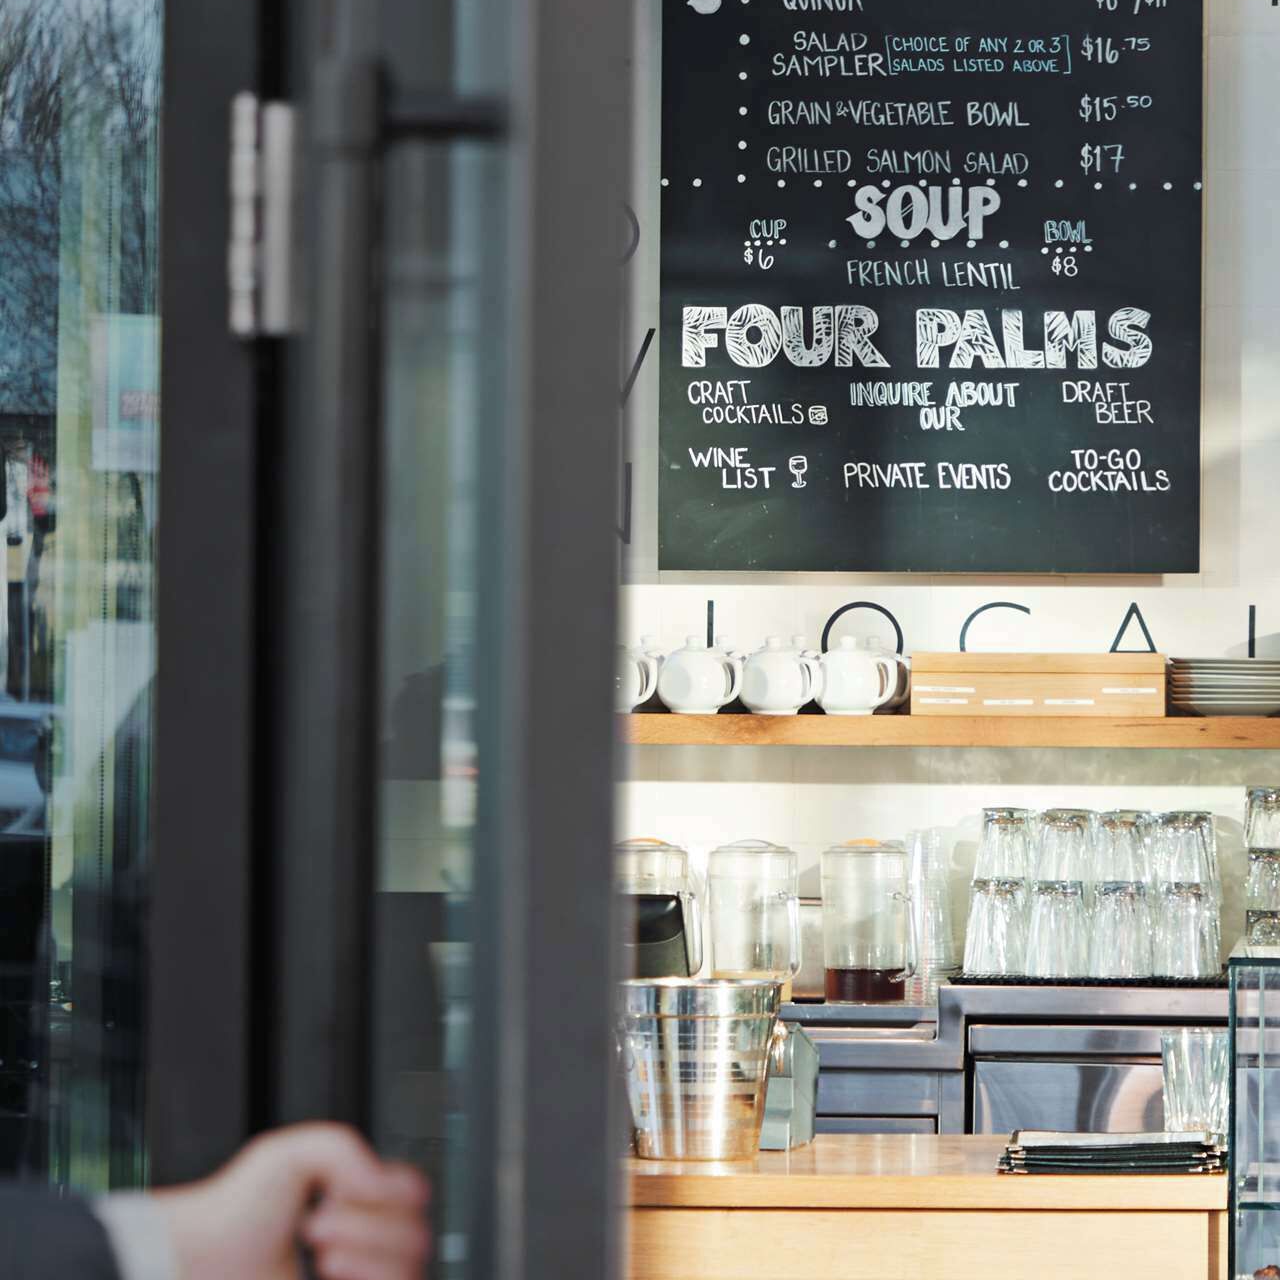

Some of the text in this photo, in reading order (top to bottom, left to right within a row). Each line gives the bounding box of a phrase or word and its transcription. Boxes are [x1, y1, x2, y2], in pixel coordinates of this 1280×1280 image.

[793, 31, 868, 51] SALAD
[892, 37, 949, 52] CHOICE
[955, 37, 971, 52] OF
[979, 38, 1008, 53] ANY
[1028, 39, 1044, 53] OR
[772, 53, 887, 77] SAMPLER
[893, 59, 944, 72] SALADS
[953, 59, 1004, 72] LISTED
[768, 100, 832, 125] GRAIN
[848, 100, 954, 126] VEGETABLE
[967, 102, 1030, 127] BOWL
[767, 143, 1126, 175] GRILLED SALMON SALAD $17
[846, 185, 1000, 240] SOUP
[750, 219, 787, 239] CUP
[1044, 220, 1093, 245] BOWL
[847, 259, 1020, 290] FRENCH LENTIL
[1052, 256, 1078, 277] $8
[682, 304, 1152, 369] FOUR PALMS
[687, 380, 751, 405] CRAFT
[850, 382, 1019, 407] INQUIRE ABOUT
[1062, 381, 1129, 403] DRAFT
[702, 404, 804, 424] COCKTAILS
[920, 406, 964, 431] OUR
[1095, 401, 1154, 423] BEER
[688, 447, 750, 468] WINE
[1071, 449, 1141, 470] TO-GO
[722, 468, 776, 489] LIST
[844, 463, 1012, 490] PRIVATE EVENTS
[1049, 470, 1170, 492] COCKTAILS
